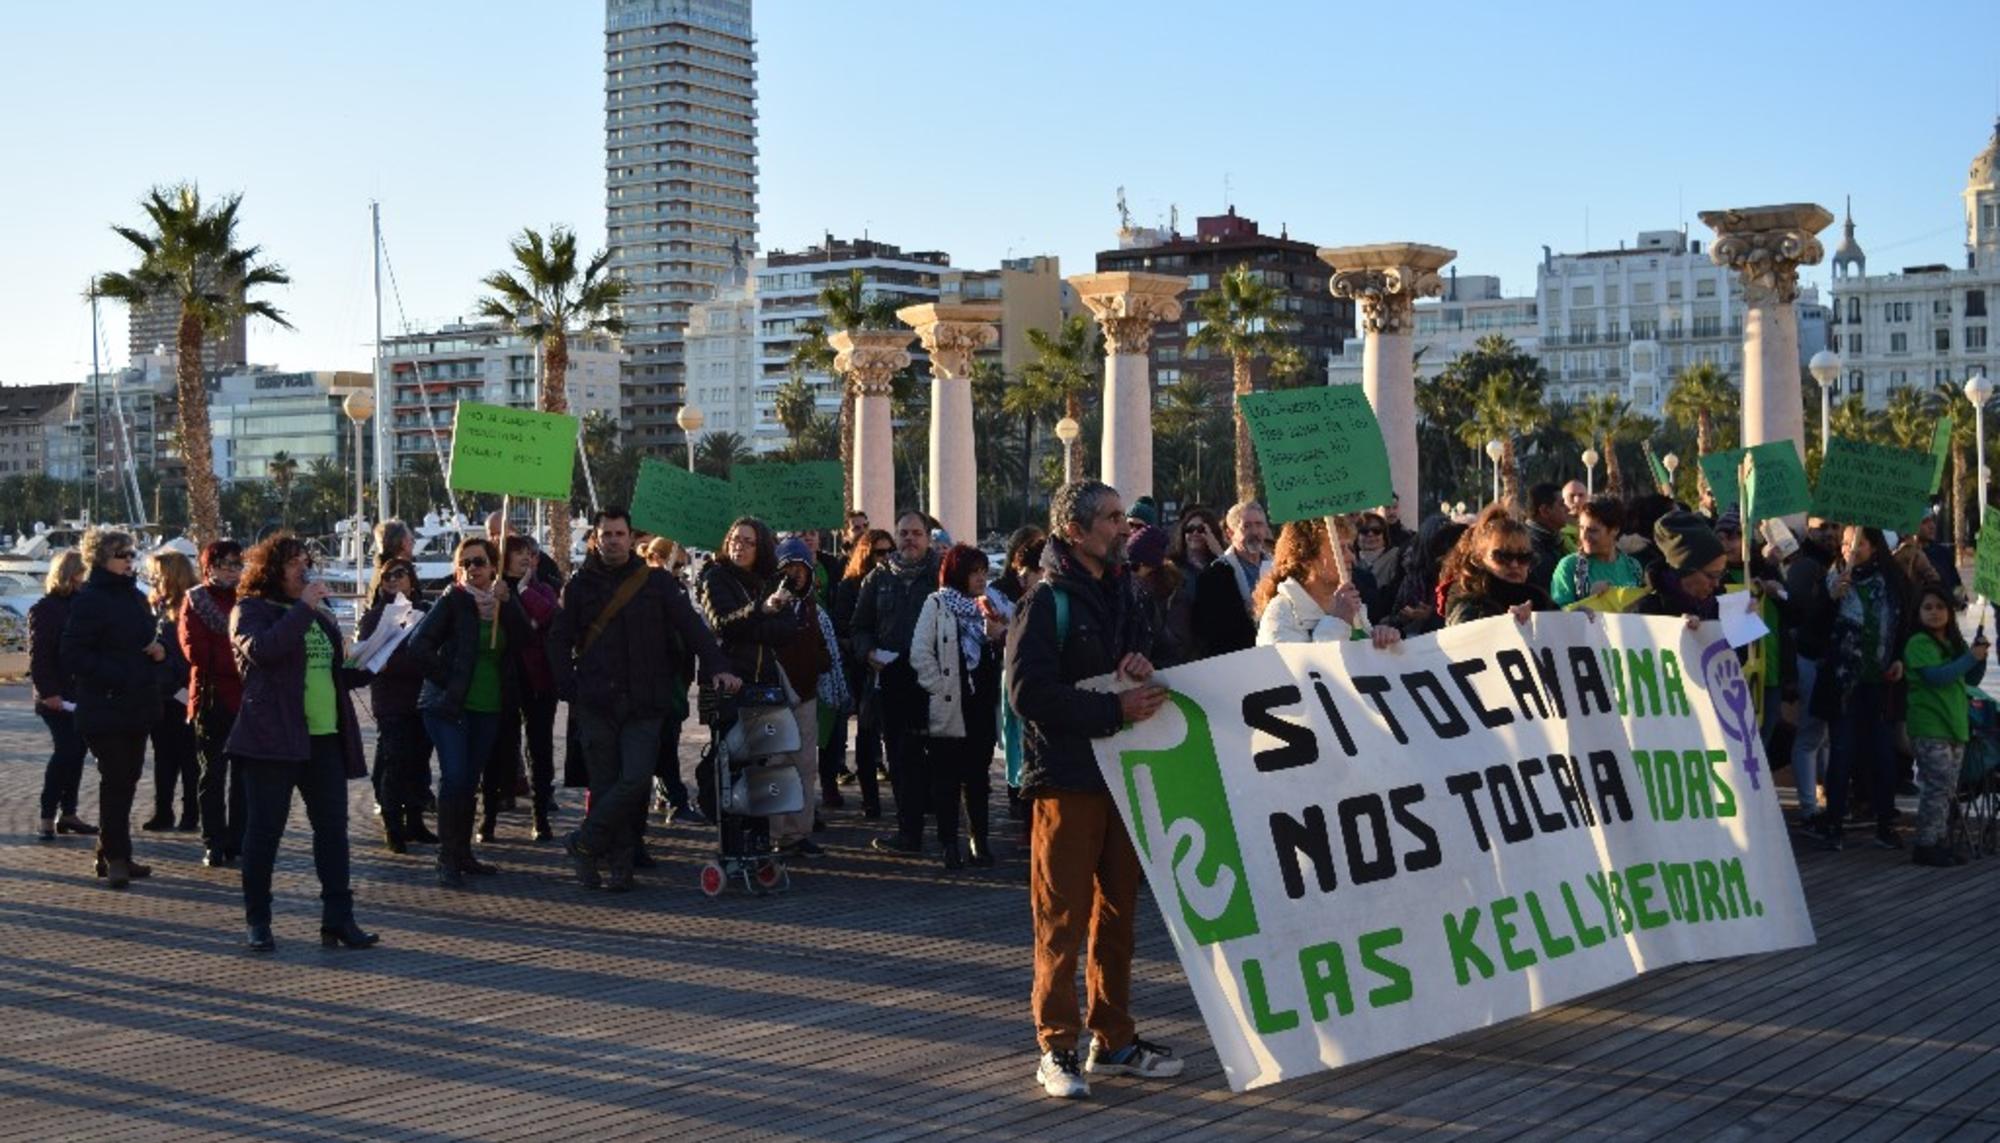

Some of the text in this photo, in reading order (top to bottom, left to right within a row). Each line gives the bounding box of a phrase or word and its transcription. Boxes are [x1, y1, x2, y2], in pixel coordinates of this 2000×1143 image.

[1351, 646, 1568, 746] TOCAN
[1567, 646, 1612, 717] A
[1600, 647, 1690, 718] UNA
[1269, 783, 1443, 900] NOS
[1588, 749, 1635, 826] A
[1242, 929, 1414, 1034] LAS
